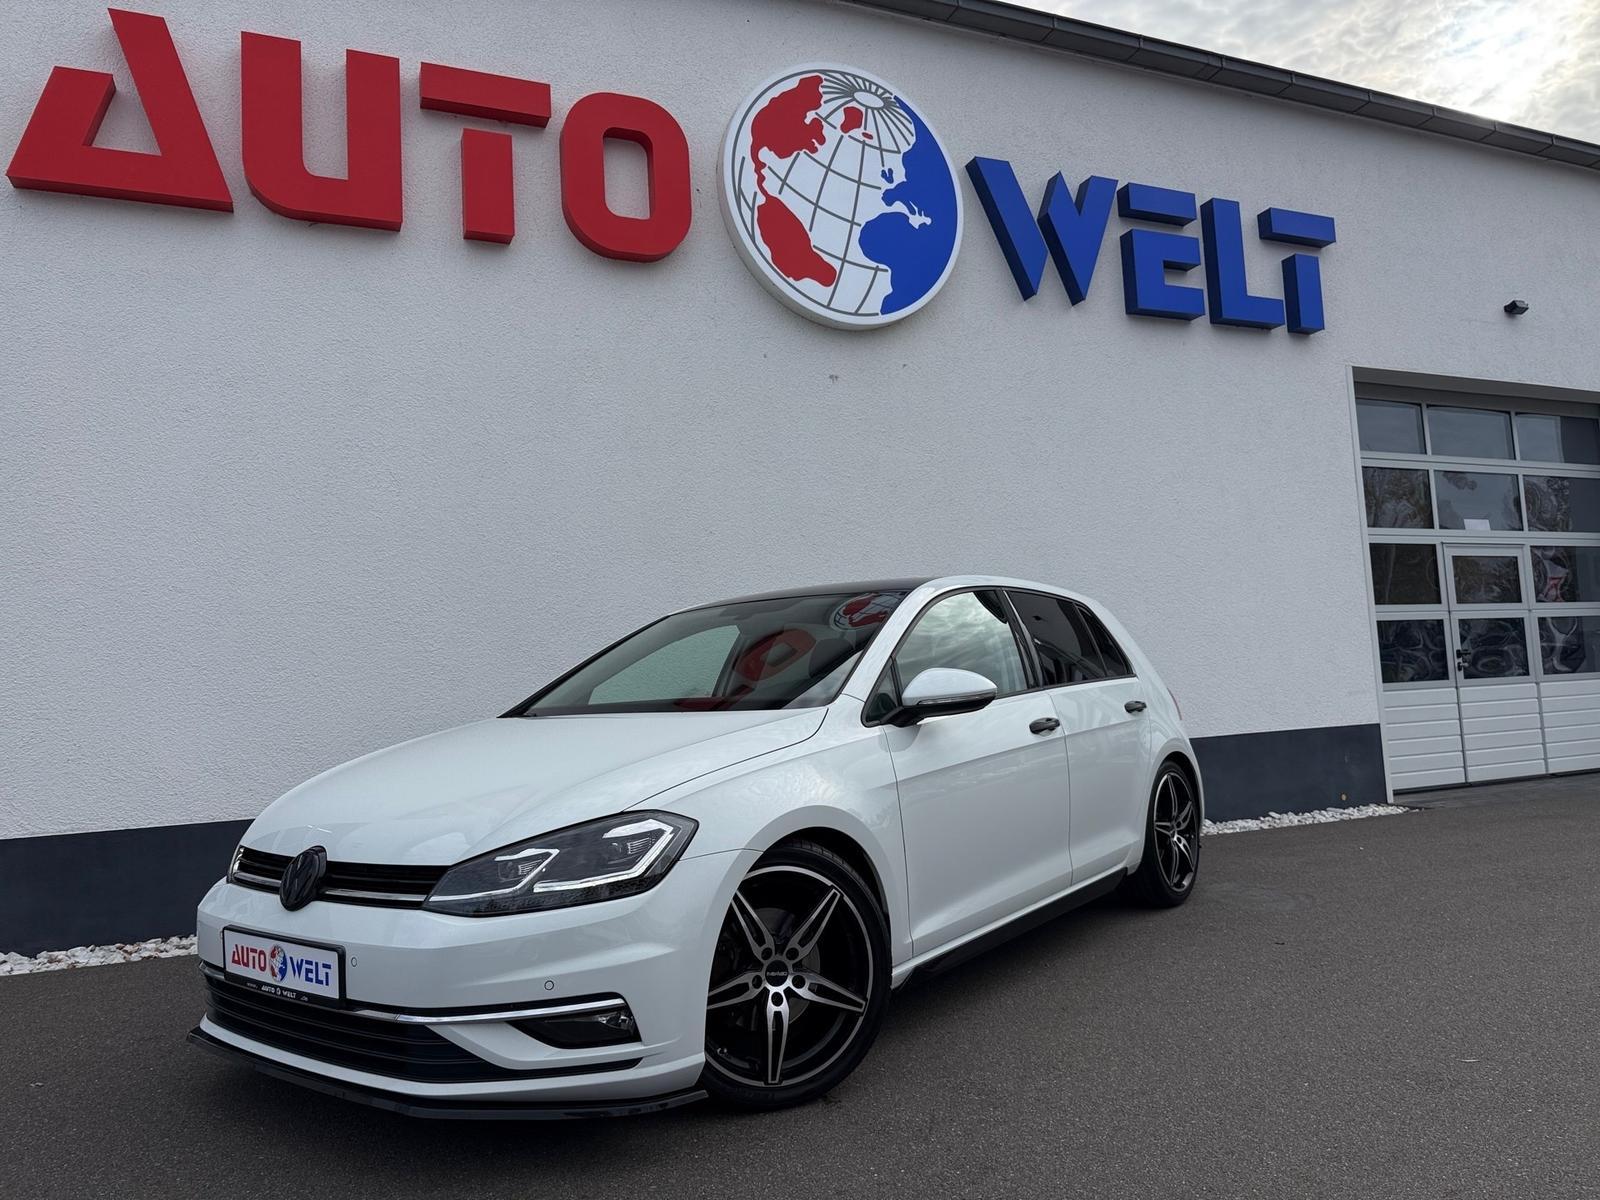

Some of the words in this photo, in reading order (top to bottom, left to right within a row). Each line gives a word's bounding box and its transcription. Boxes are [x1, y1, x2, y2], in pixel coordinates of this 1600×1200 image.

[6, 8, 692, 263] AUTO
[965, 156, 1336, 335] WELT
[232, 944, 266, 972] AUTO
[289, 956, 332, 986] WELT
